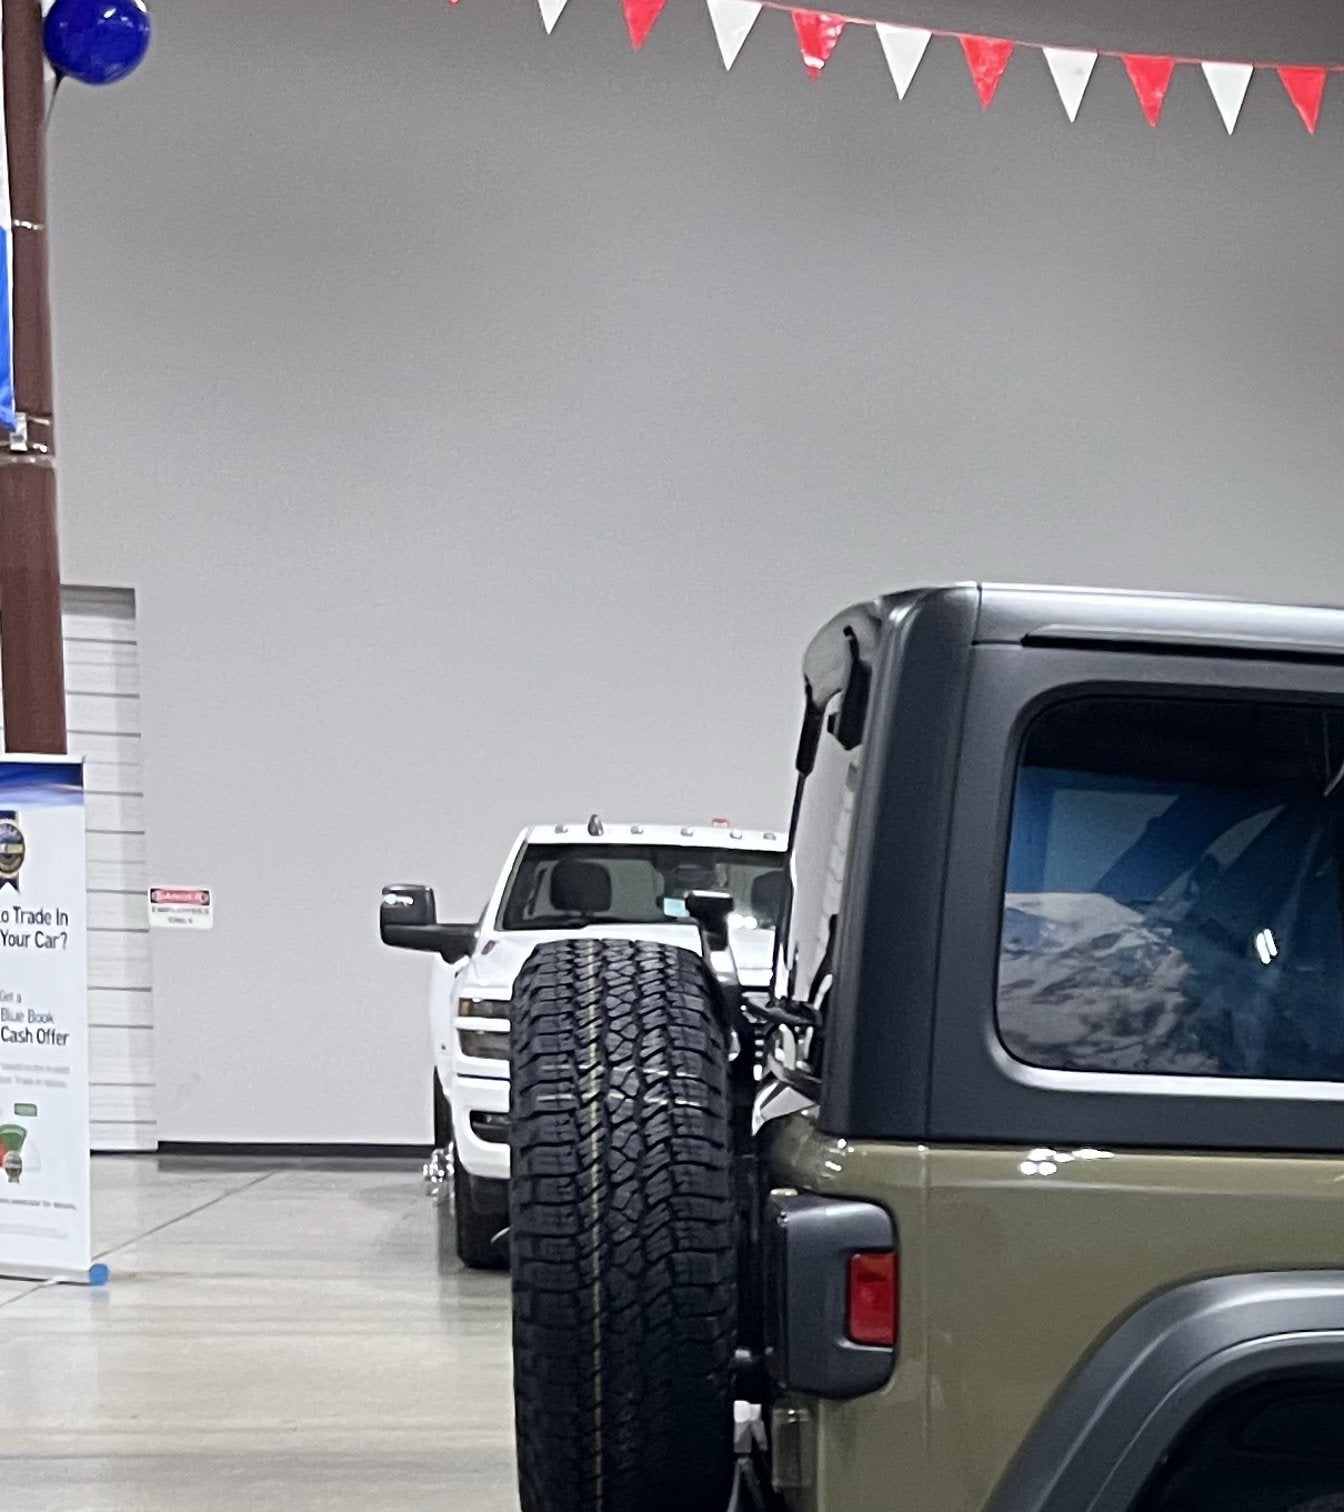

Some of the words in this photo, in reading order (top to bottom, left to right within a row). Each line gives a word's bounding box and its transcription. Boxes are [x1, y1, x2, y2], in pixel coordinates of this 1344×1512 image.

[13, 905, 52, 926] Trade
[56, 907, 69, 927] In
[0, 929, 31, 948] Your
[34, 930, 68, 950] Car?
[27, 1008, 55, 1024] Book
[1, 1025, 34, 1044] Cash
[36, 1027, 70, 1046] Offer
